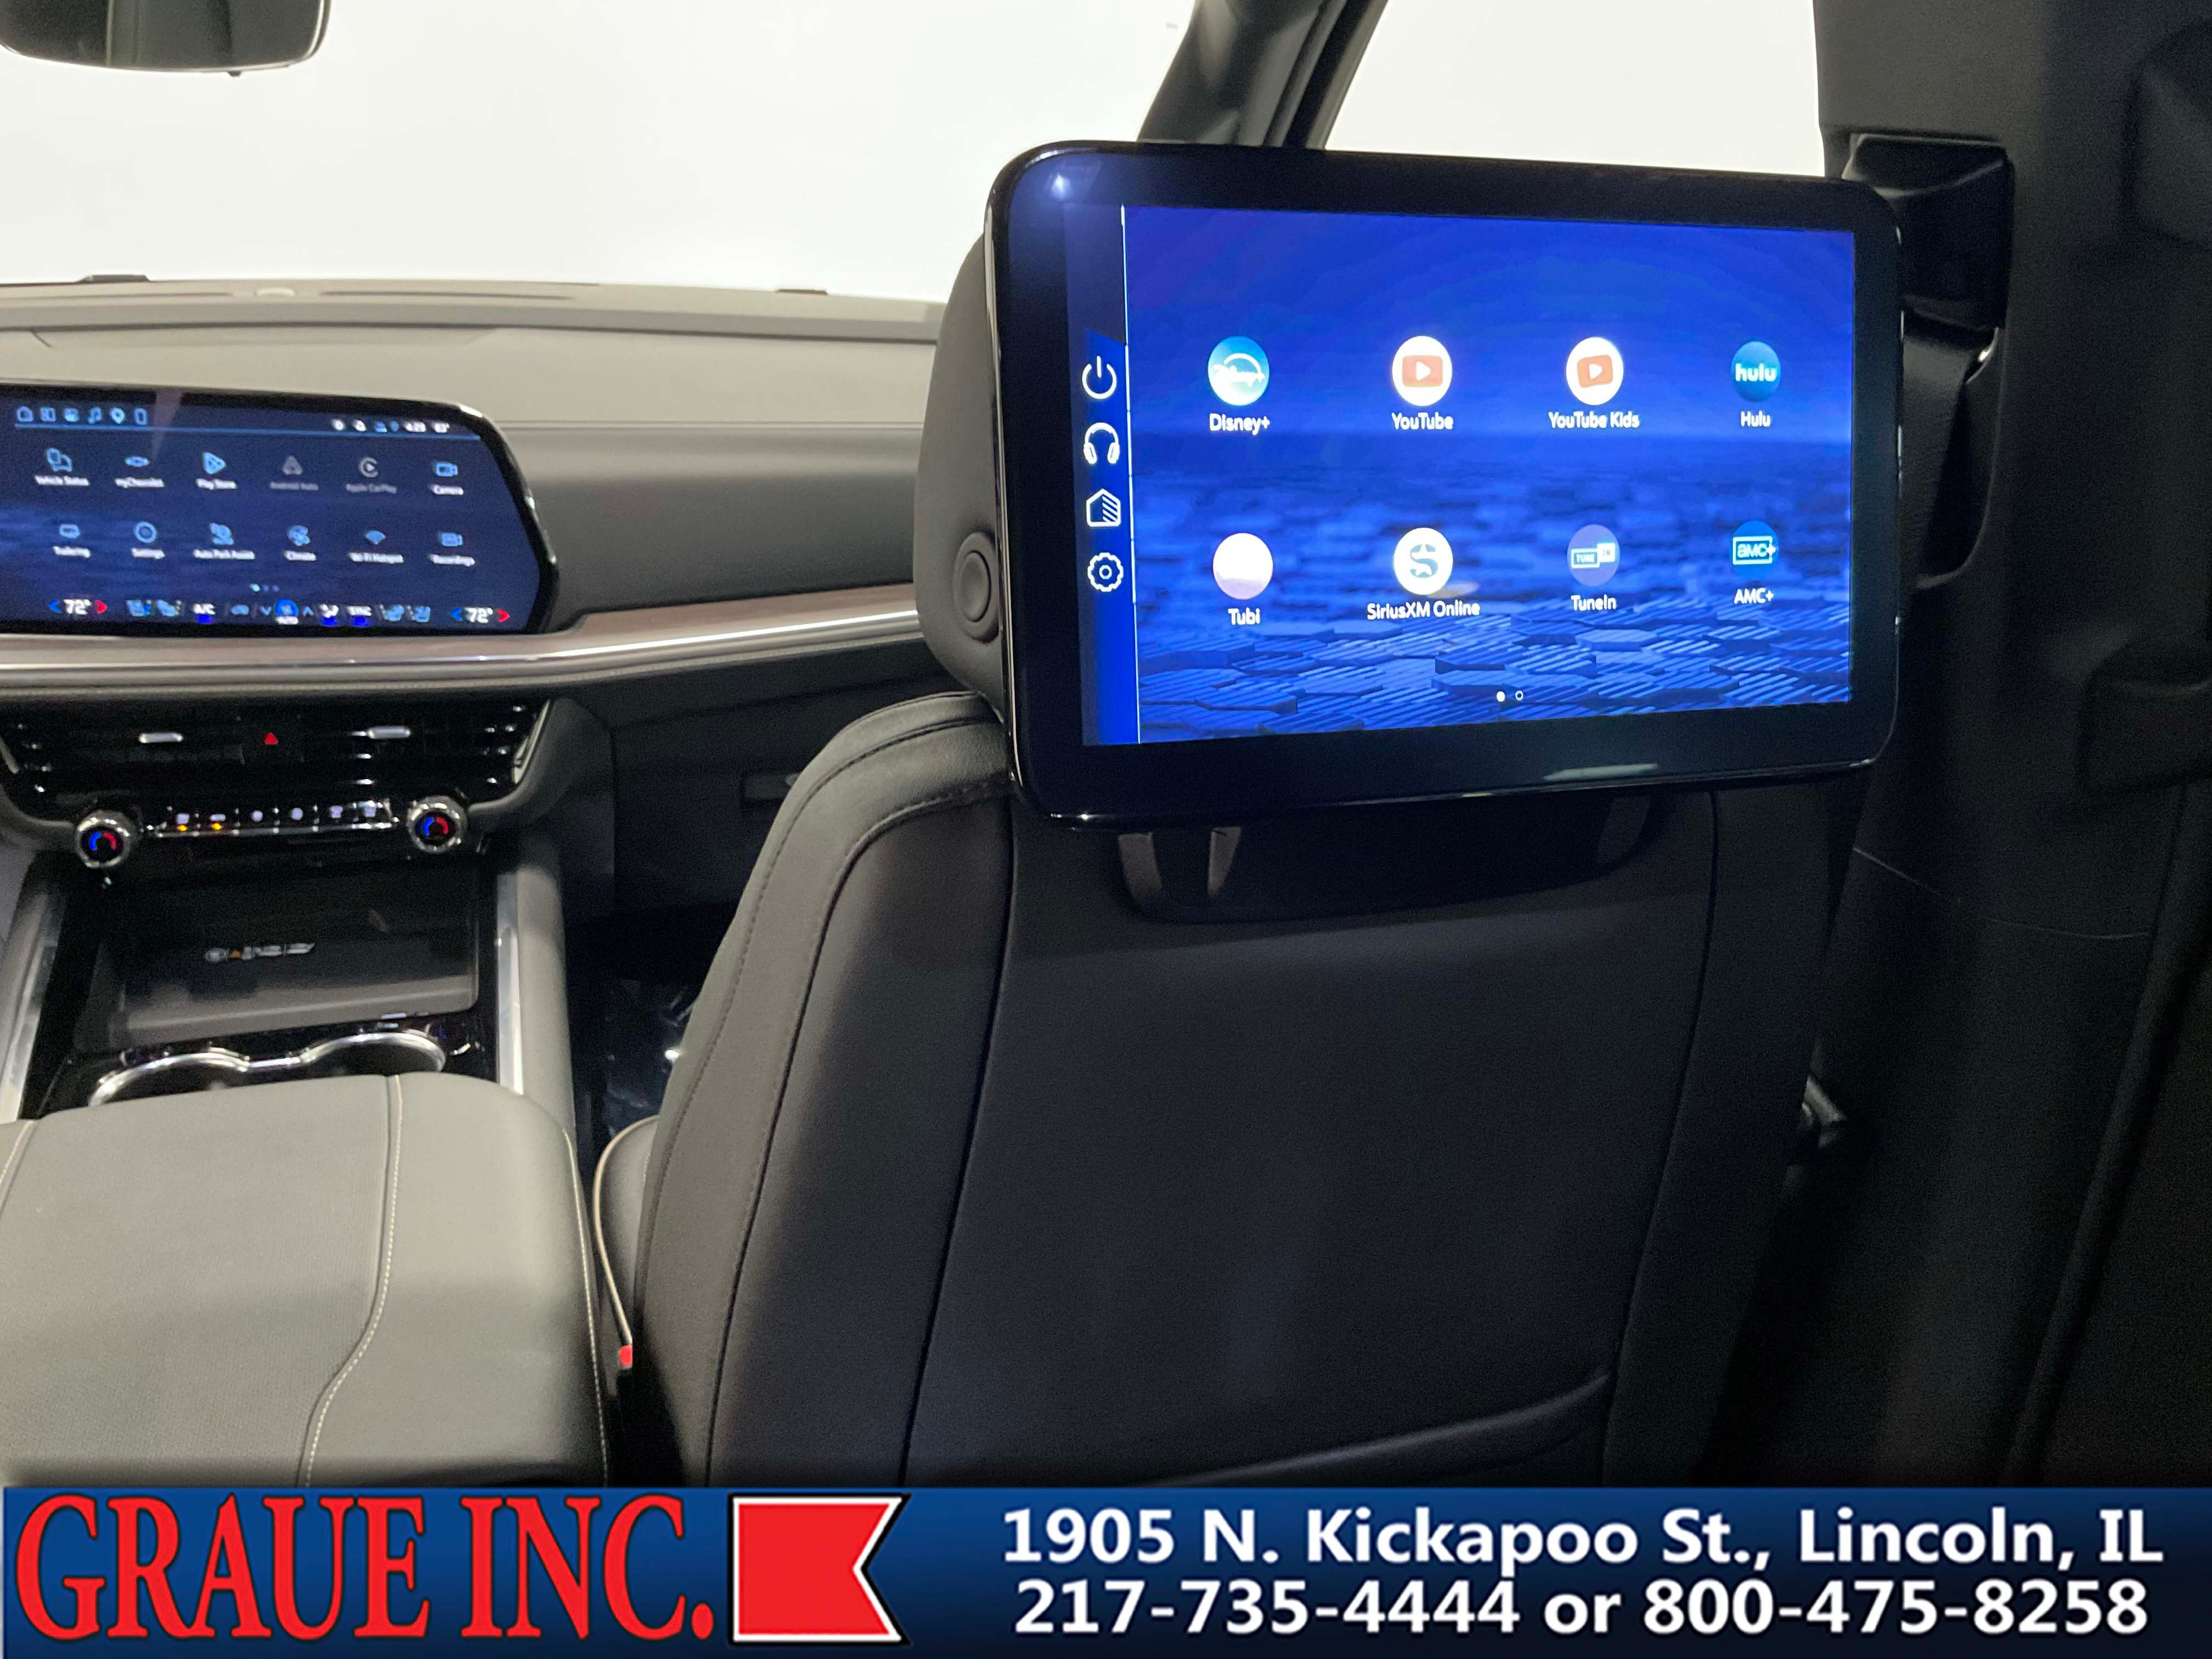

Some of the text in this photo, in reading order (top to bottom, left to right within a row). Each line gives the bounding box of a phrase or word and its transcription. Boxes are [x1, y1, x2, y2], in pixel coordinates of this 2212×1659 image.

[1735, 363, 1776, 381] hulu
[1209, 413, 1270, 436] Disney+
[1391, 411, 1453, 430] YouTube
[1548, 411, 1640, 428] YouTube Kids
[1741, 410, 1771, 427] Hulu
[1571, 594, 1617, 611] TuneIn
[1734, 588, 1774, 604] AMC+
[1228, 607, 1260, 625] Tubi
[1367, 599, 1481, 620] SiriusXM Online
